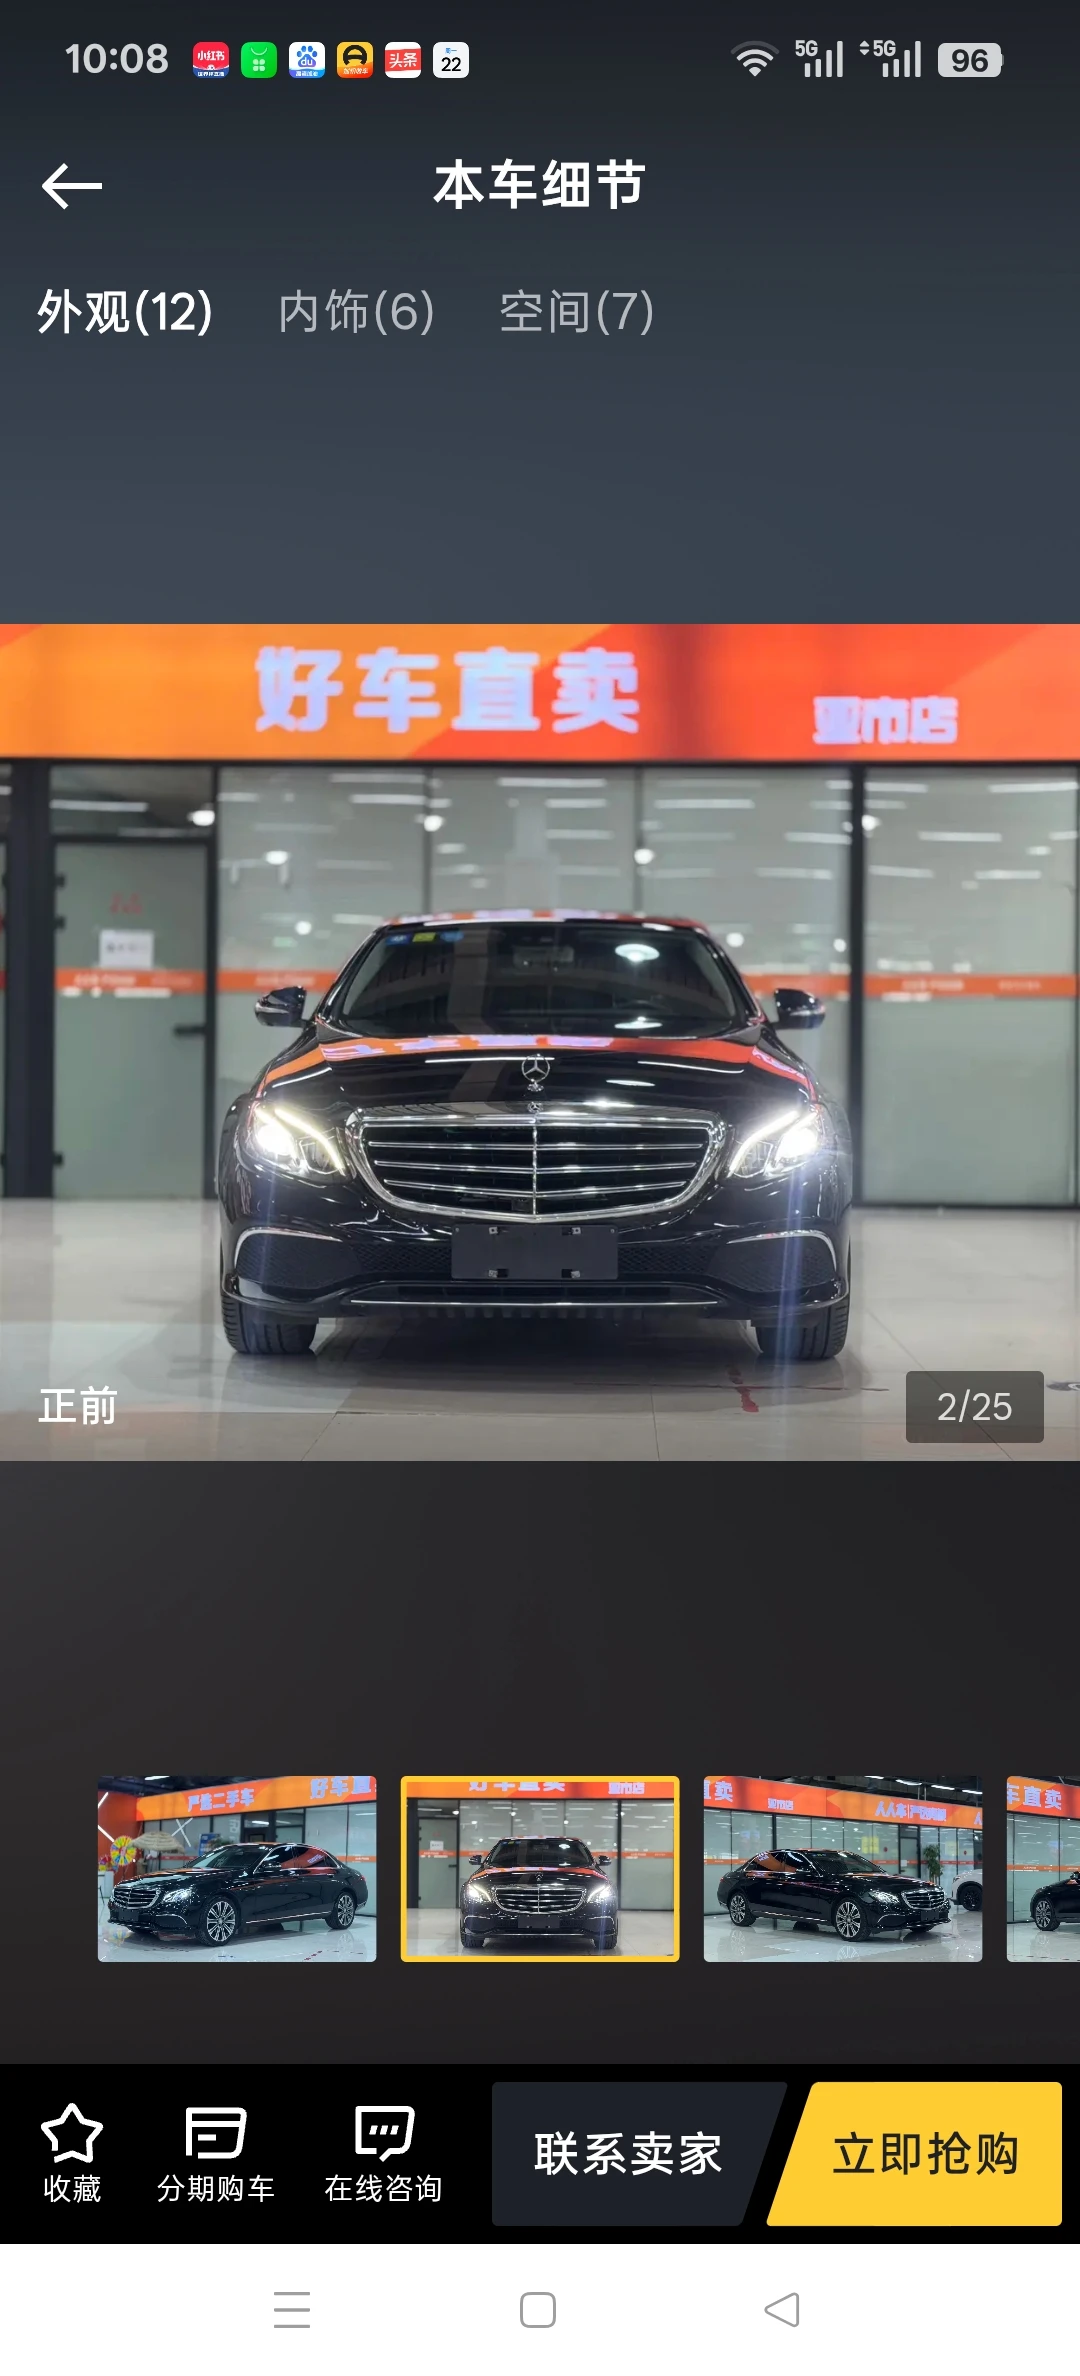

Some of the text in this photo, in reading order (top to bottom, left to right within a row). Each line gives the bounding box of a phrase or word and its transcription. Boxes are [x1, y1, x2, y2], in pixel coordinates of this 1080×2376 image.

[66, 44, 169, 73] 10:08
[198, 50, 225, 61] 小红书
[300, 57, 313, 66] du
[389, 52, 417, 69] 头条
[795, 40, 818, 57] 5G
[873, 40, 896, 57] 5G
[951, 49, 989, 73] 96
[441, 57, 461, 72] 22
[433, 158, 646, 210] 本车细节
[37, 288, 212, 337] 外观(12)
[280, 288, 434, 336] 内饰(6)
[500, 288, 653, 336] 空间(7)
[255, 646, 639, 734] 好车直卖
[310, 1777, 377, 1800] 好车直
[534, 2130, 723, 2176] 联系卖家
[832, 2130, 1018, 2176] 立即抢购
[43, 2174, 102, 2204] 收藏
[157, 2174, 275, 2203] 分期购车
[324, 2174, 442, 2203] 在线咨询
